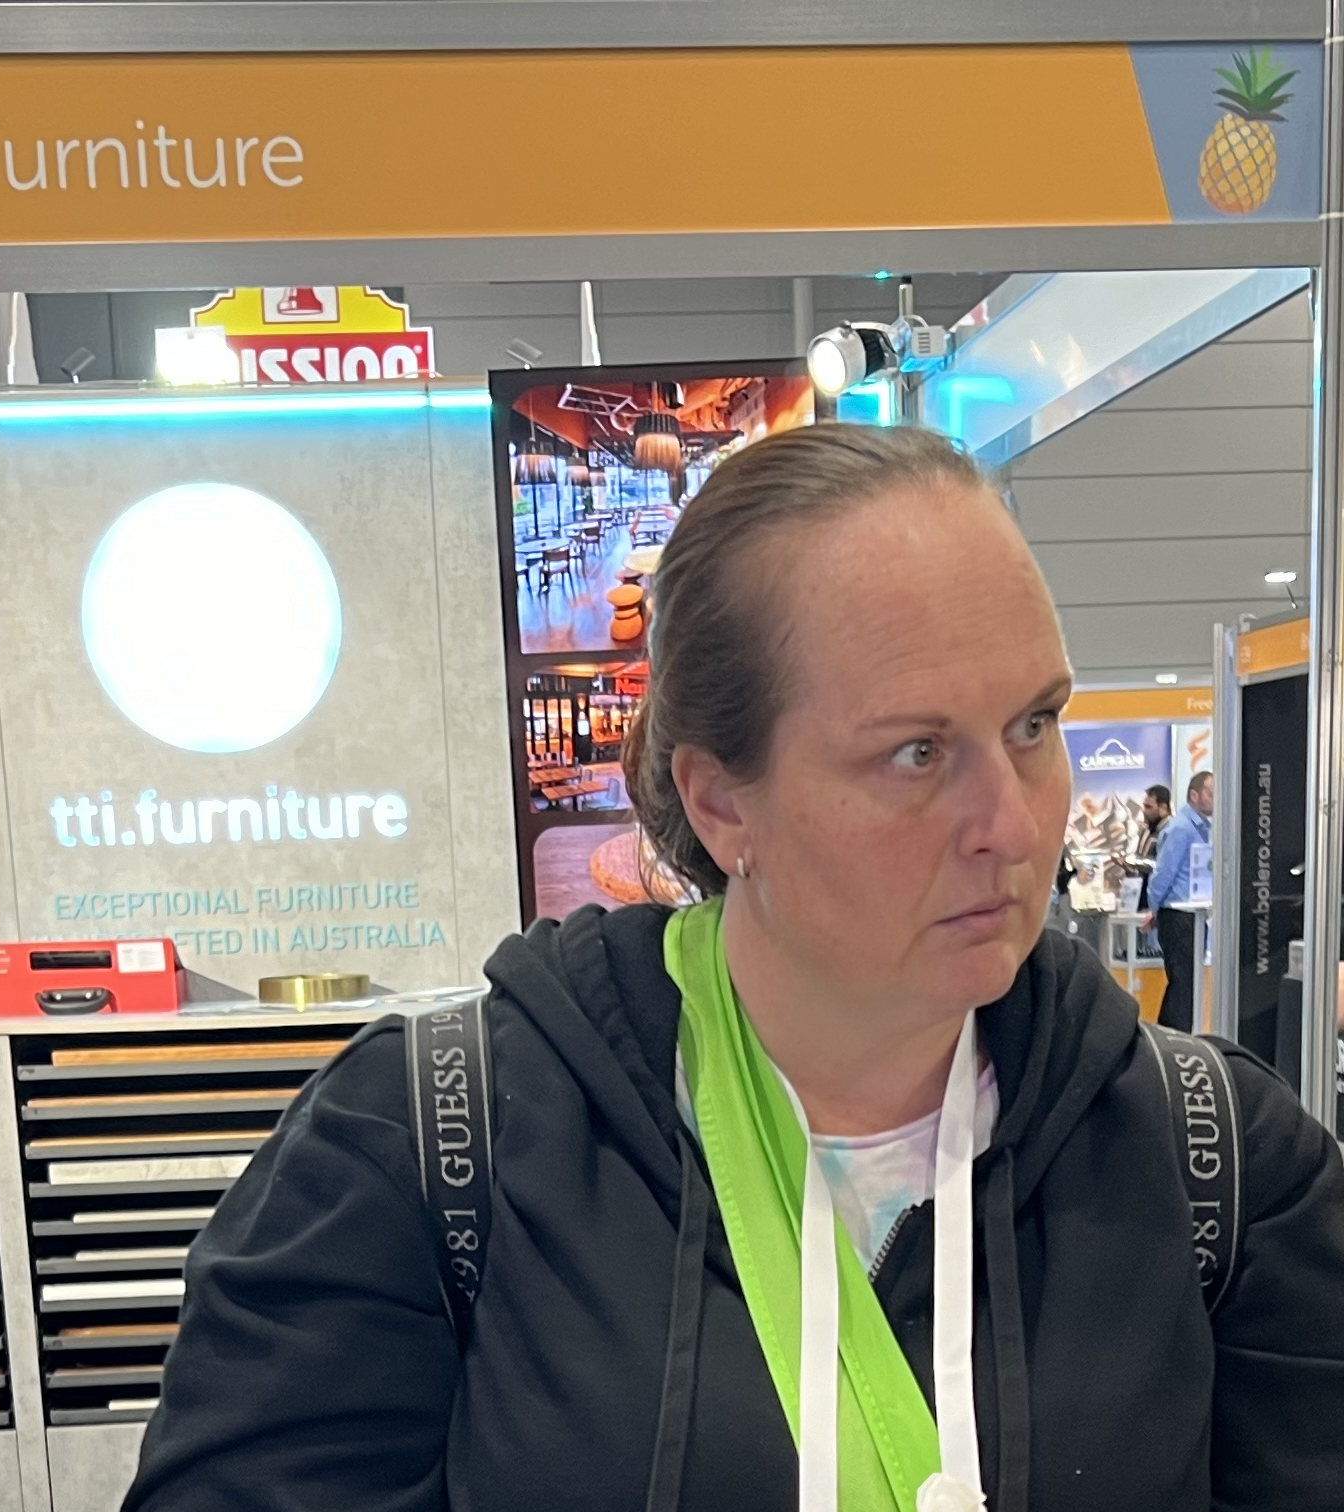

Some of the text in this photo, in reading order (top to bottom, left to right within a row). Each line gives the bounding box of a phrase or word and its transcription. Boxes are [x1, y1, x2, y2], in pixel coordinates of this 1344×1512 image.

[240, 345, 419, 384] ISSION
[50, 784, 408, 848] tti.furniture
[55, 880, 420, 921] EXCEPTIONAL FURNITURE
[255, 927, 280, 953] IN
[290, 921, 446, 952] AUSTRALIA
[432, 1046, 474, 1188] GUESS
[1175, 1053, 1221, 1181] GUESS
